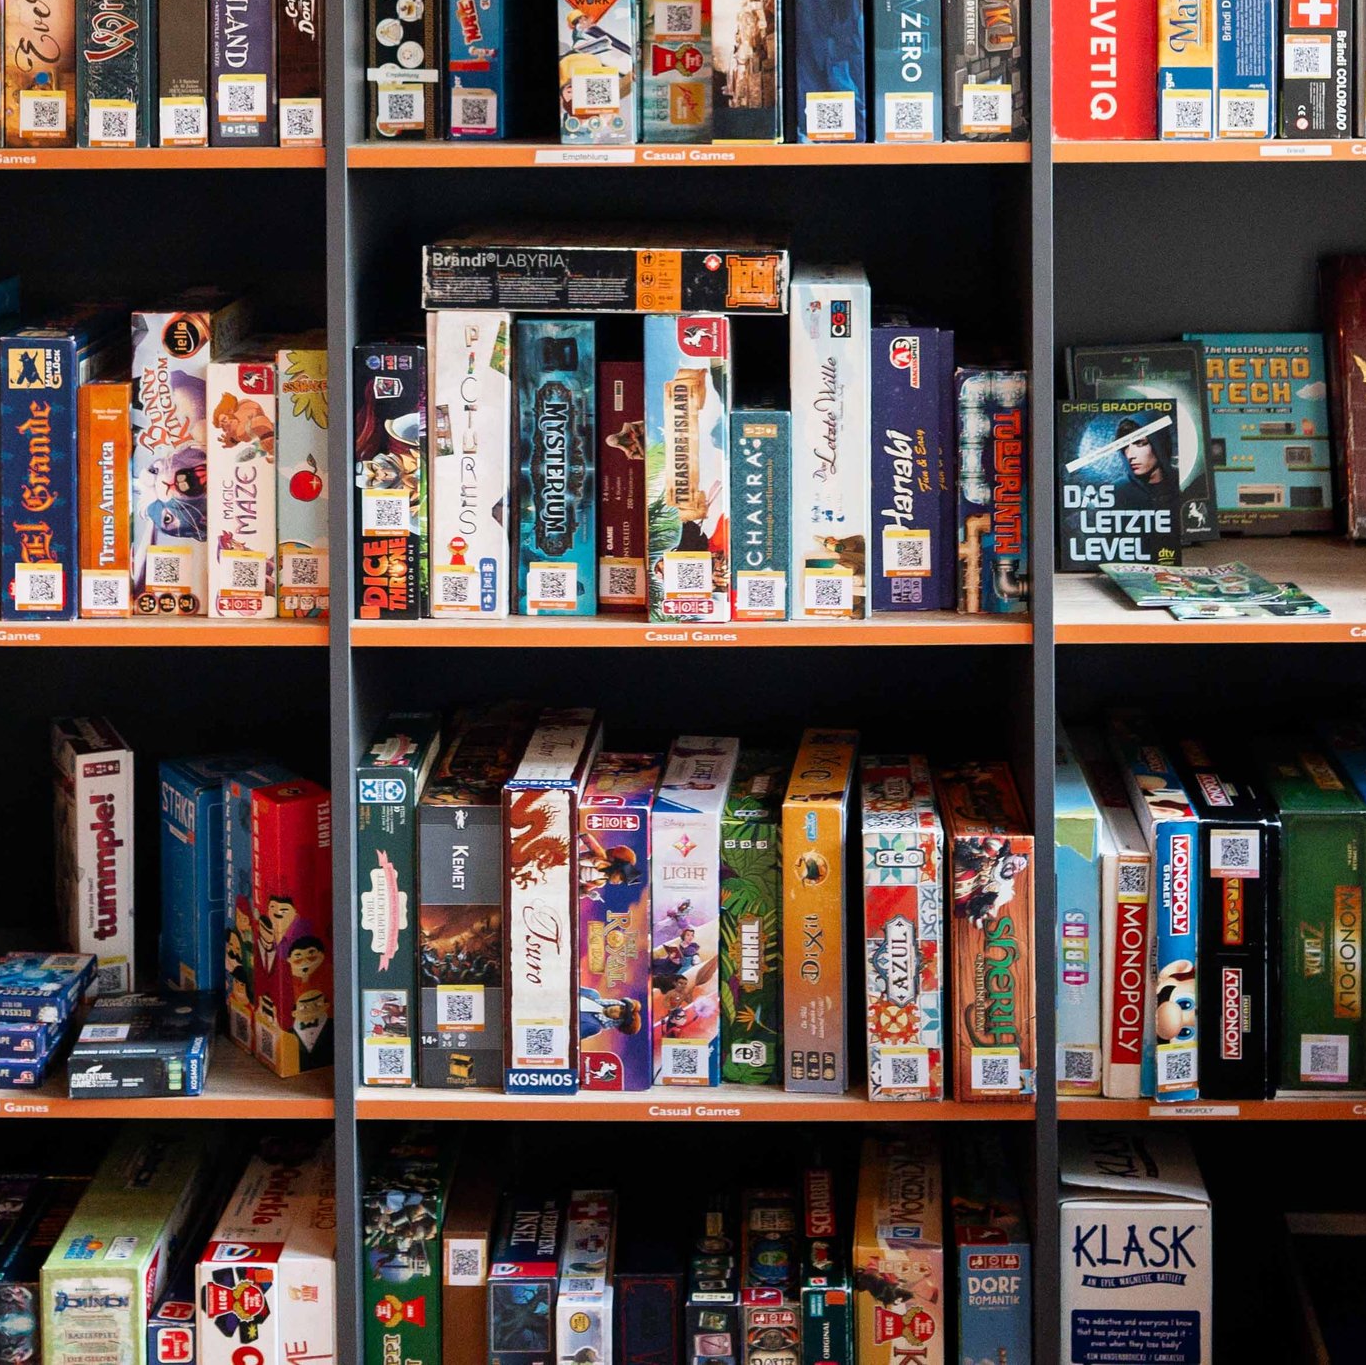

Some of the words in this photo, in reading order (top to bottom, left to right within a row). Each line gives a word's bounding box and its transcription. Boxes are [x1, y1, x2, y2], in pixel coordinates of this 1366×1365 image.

[1222, 10, 1231, 41] Brändi
[900, 12, 922, 82] ZERO
[1337, 31, 1346, 68] Brändi
[1336, 71, 1347, 130] COLORADO
[643, 150, 686, 161] Casual
[691, 150, 735, 161] Games
[1206, 358, 1310, 379] RETRO
[159, 357, 194, 448] KINGDOM
[676, 384, 688, 434] ISLAND
[1062, 404, 1099, 413] CHRIS
[1102, 403, 1172, 412] BRADFORD
[1207, 383, 1291, 404] TECH
[18, 402, 57, 511] Grande
[543, 402, 570, 535] MYSTERIUM
[676, 439, 688, 504] TREASURE
[224, 480, 233, 519] MAGIC
[237, 466, 256, 534] MAZE
[994, 411, 1021, 553] TUBYRINTH
[1064, 485, 1115, 508] DAS
[747, 452, 763, 565] CHAKRA
[1080, 510, 1170, 533] LETZTE
[1070, 538, 1151, 561] LEVEL
[1159, 549, 1175, 558] dtv
[365, 540, 388, 608] DICE
[389, 538, 407, 610] THRONE
[645, 631, 689, 641] Casual
[694, 631, 737, 641] Games
[318, 800, 329, 848] KARTEL
[92, 794, 125, 939] tummple!
[453, 845, 469, 890] KEMET
[662, 867, 708, 879] LIGHT
[1173, 837, 1188, 934] MONOPOLY
[893, 933, 907, 990] AZUL
[1337, 892, 1355, 1011] MONOPOLY
[1119, 906, 1142, 1053] MONOPOLY
[1224, 970, 1239, 1057] MONOPOLY
[422, 1036, 436, 1044] 14+
[71, 1072, 109, 1081] ADVENTURE
[189, 1059, 198, 1090] KOSMOS
[509, 1074, 572, 1086] KOSMOS
[5, 1102, 48, 1113] Games
[648, 1106, 692, 1116] Casual
[697, 1106, 740, 1116] Games
[1072, 1224, 1196, 1269] KLASK
[966, 1276, 1021, 1294] DORF
[969, 1294, 1021, 1305] ROMANTIK
[1101, 1278, 1115, 1287] EPIC
[1157, 1274, 1181, 1282] BATTLE!
